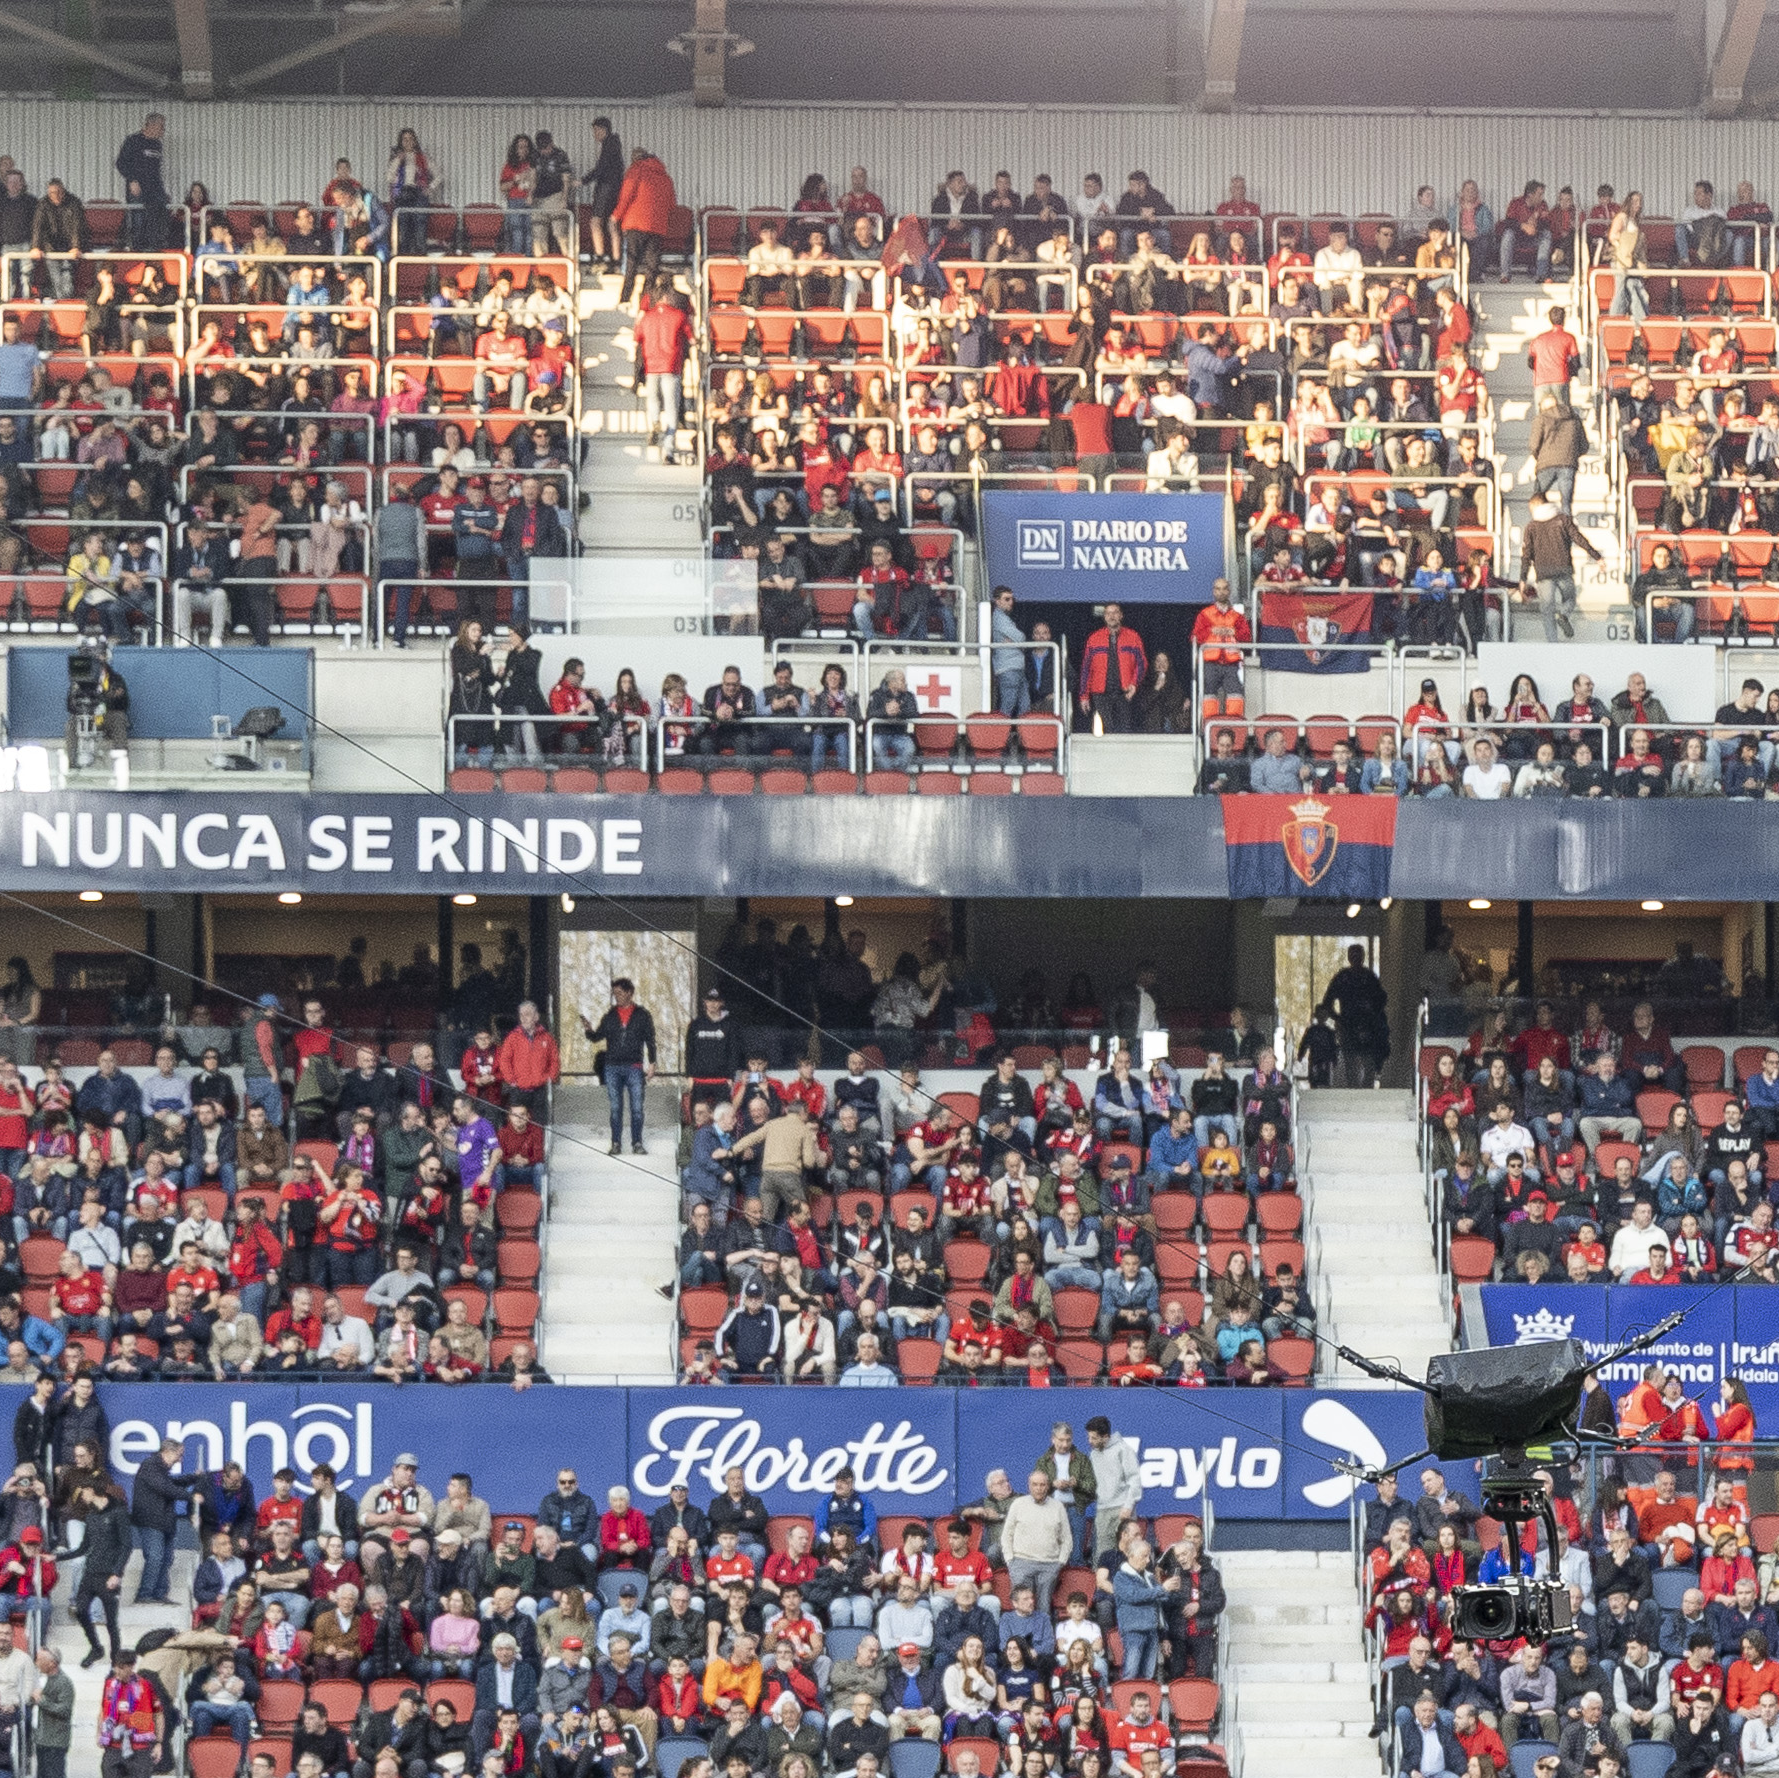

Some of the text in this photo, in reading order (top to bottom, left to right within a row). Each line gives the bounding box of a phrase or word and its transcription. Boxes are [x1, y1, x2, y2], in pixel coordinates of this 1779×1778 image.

[1024, 528, 1058, 550] DN
[1072, 521, 1188, 543] DIARIO DE
[1072, 546, 1189, 571] NAVARRA
[21, 811, 287, 871] NUNCA
[307, 815, 394, 873] SE
[418, 815, 643, 876] RINDE
[1692, 1341, 1714, 1357] de
[634, 1405, 948, 1498] Florette
[1136, 1437, 1282, 1501] aylo
